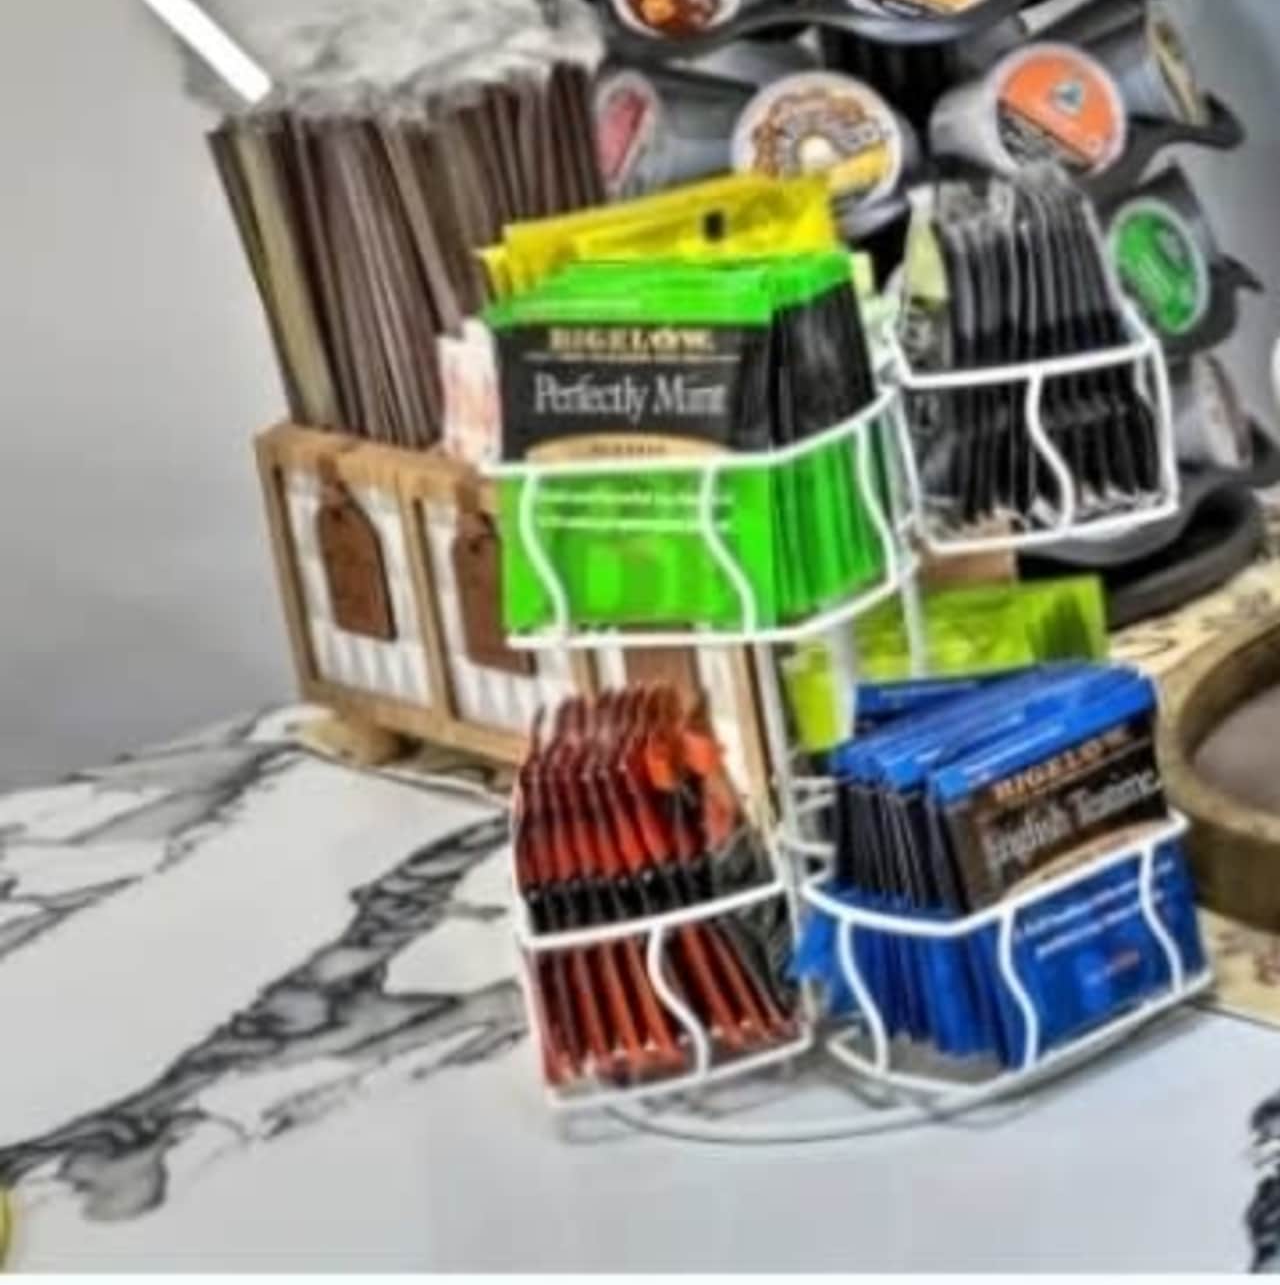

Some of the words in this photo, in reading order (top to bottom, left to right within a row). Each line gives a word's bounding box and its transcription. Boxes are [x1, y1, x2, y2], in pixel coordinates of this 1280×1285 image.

[548, 326, 716, 353] BIGELOW
[533, 372, 647, 423] Perfectly
[652, 373, 730, 415] Mint
